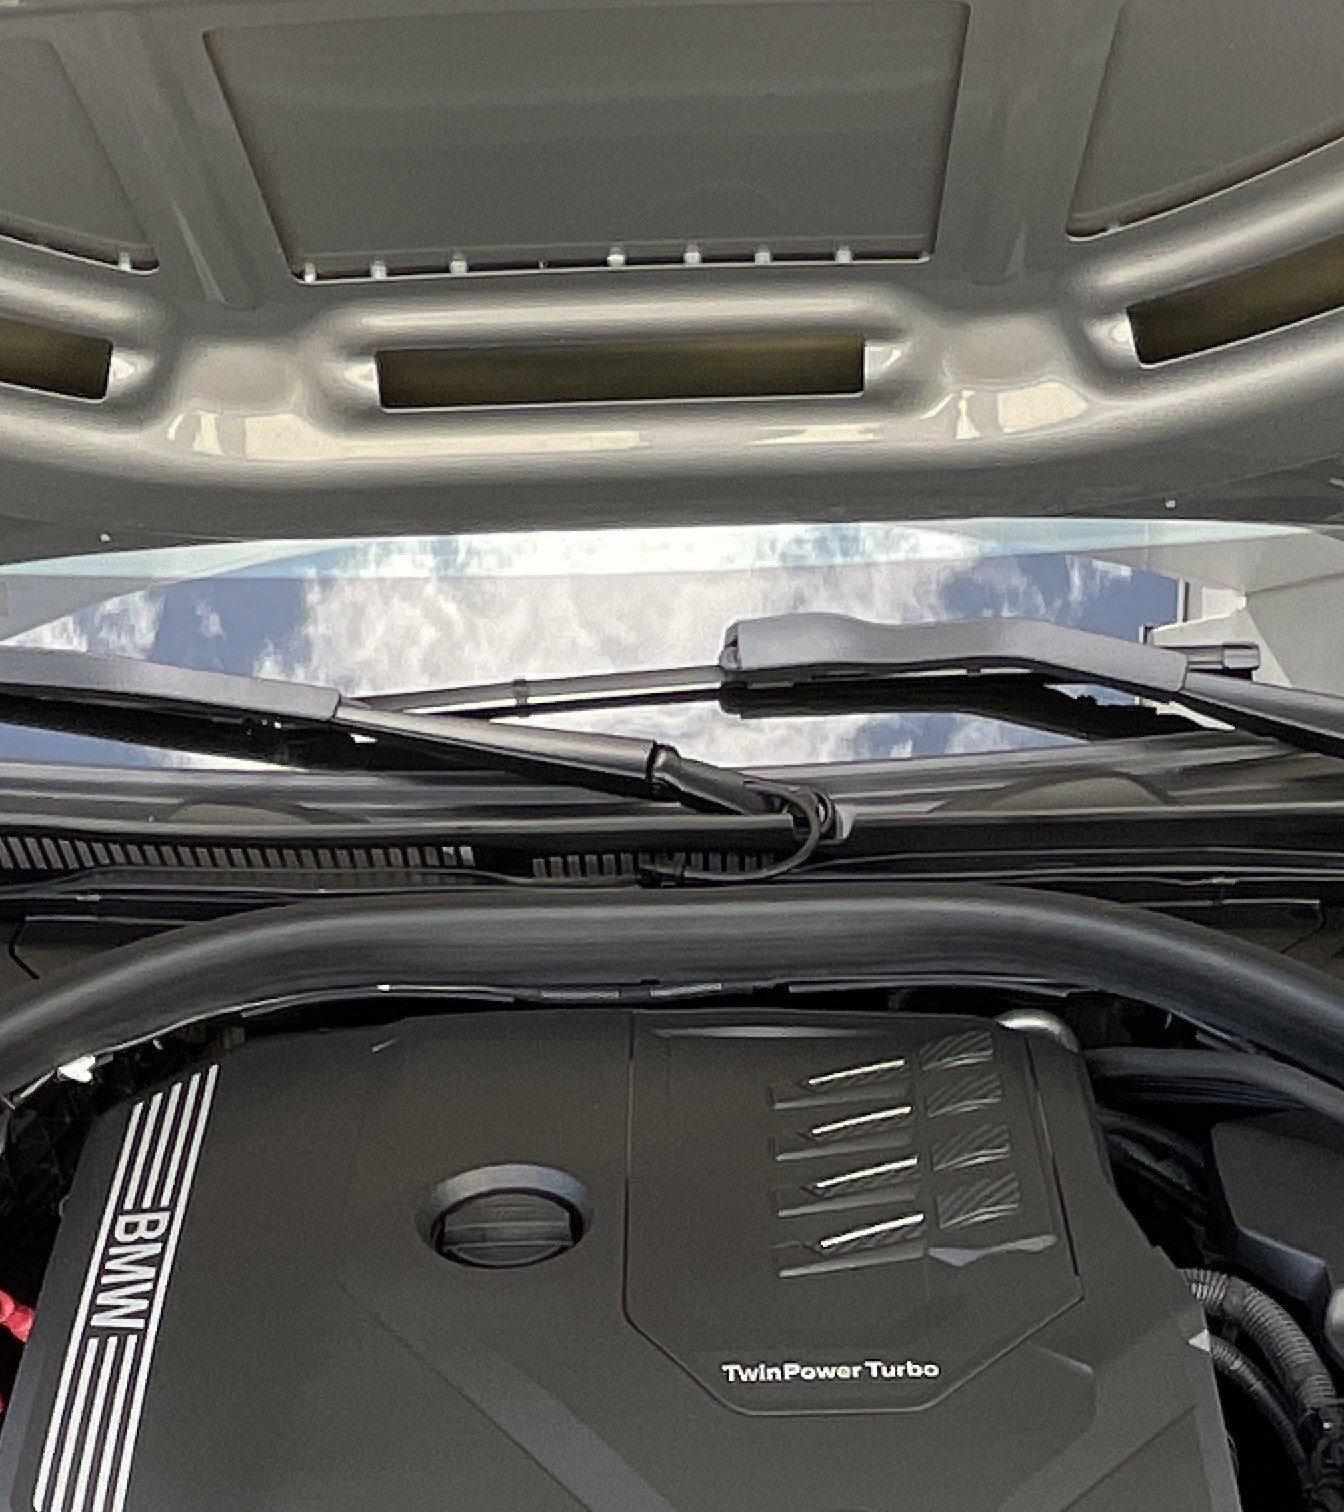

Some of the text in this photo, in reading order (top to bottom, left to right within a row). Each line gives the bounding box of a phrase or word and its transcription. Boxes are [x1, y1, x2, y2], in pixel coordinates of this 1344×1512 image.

[90, 1209, 169, 1330] BMW
[721, 1360, 940, 1382] TwinPower Turbo
